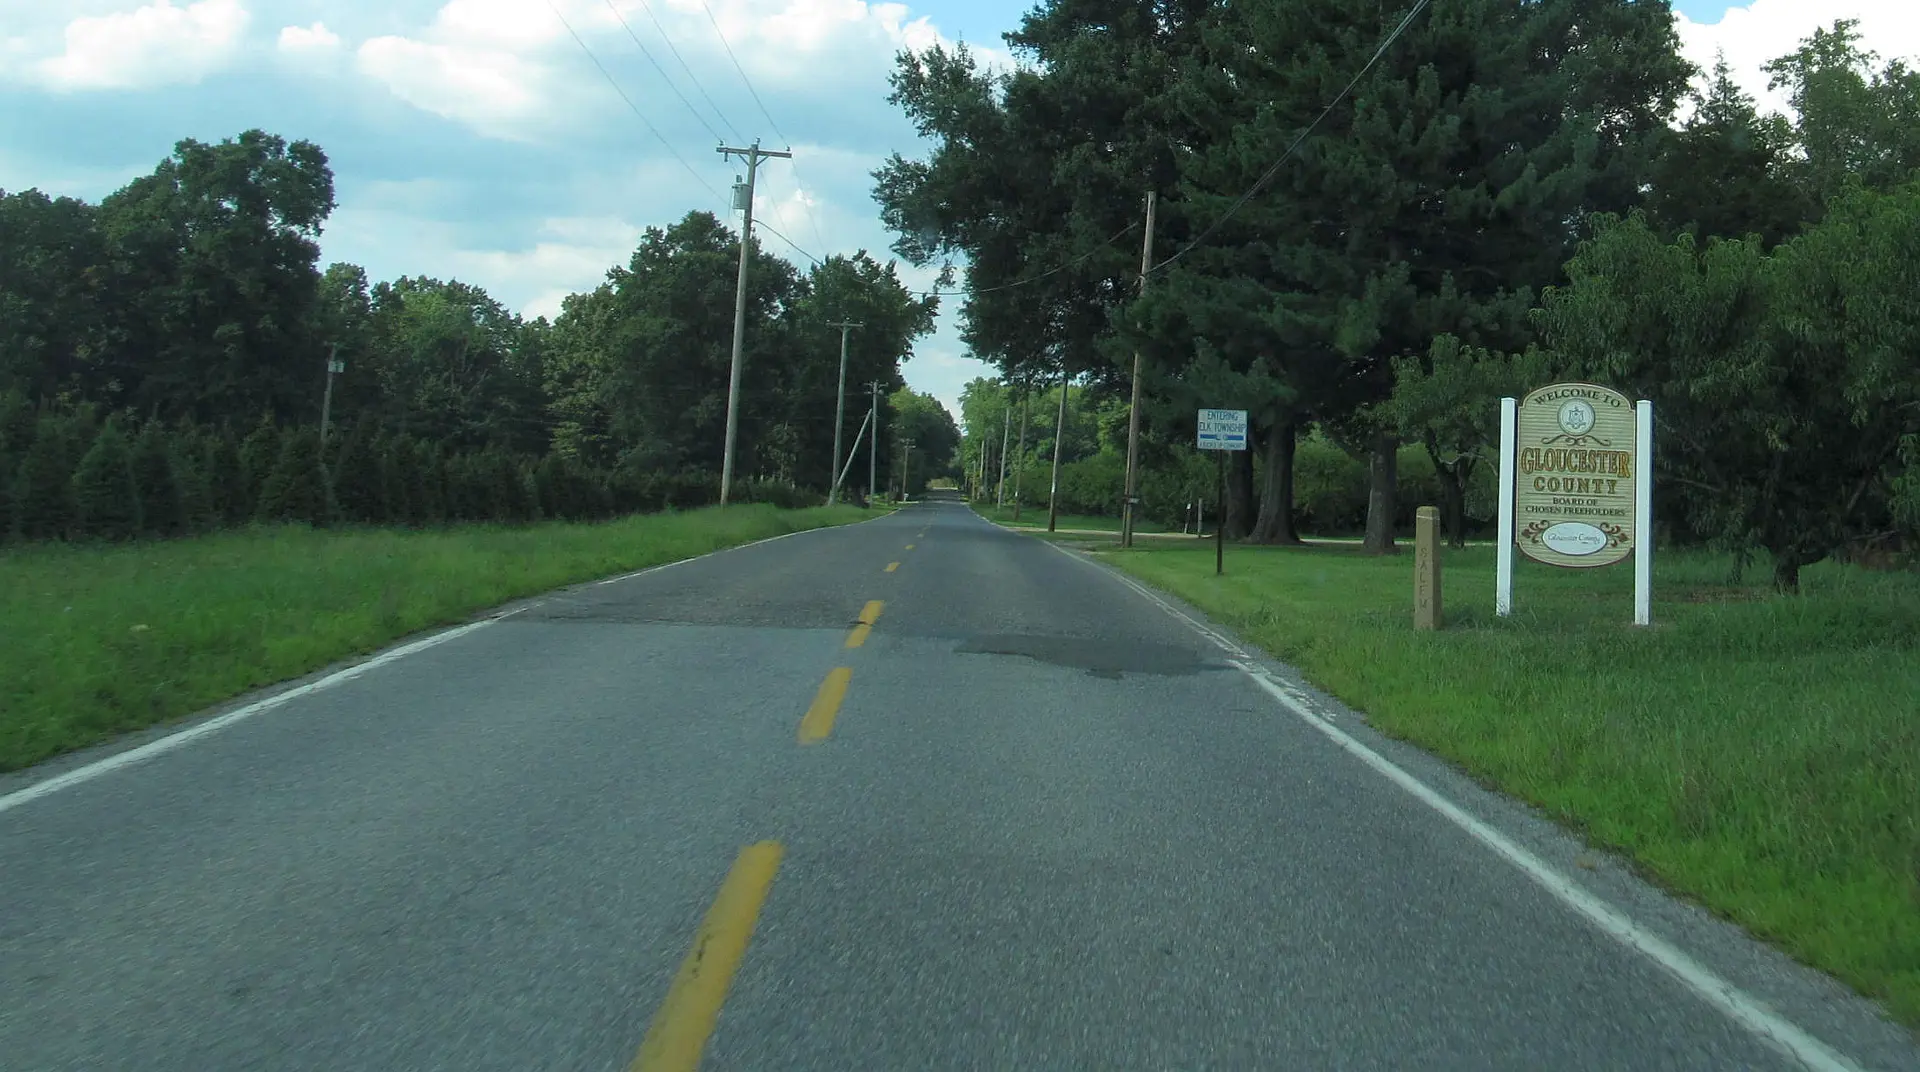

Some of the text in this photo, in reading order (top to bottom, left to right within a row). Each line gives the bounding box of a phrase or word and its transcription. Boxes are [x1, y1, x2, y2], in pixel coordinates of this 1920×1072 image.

[1534, 388, 1621, 408] WELCOME TO
[1521, 447, 1631, 478] GLOUCESTER
[1533, 477, 1617, 494] COUNTY
[1553, 497, 1599, 507] BOARD OF
[1525, 505, 1626, 517] CHOSEN FREEHOLDERS
